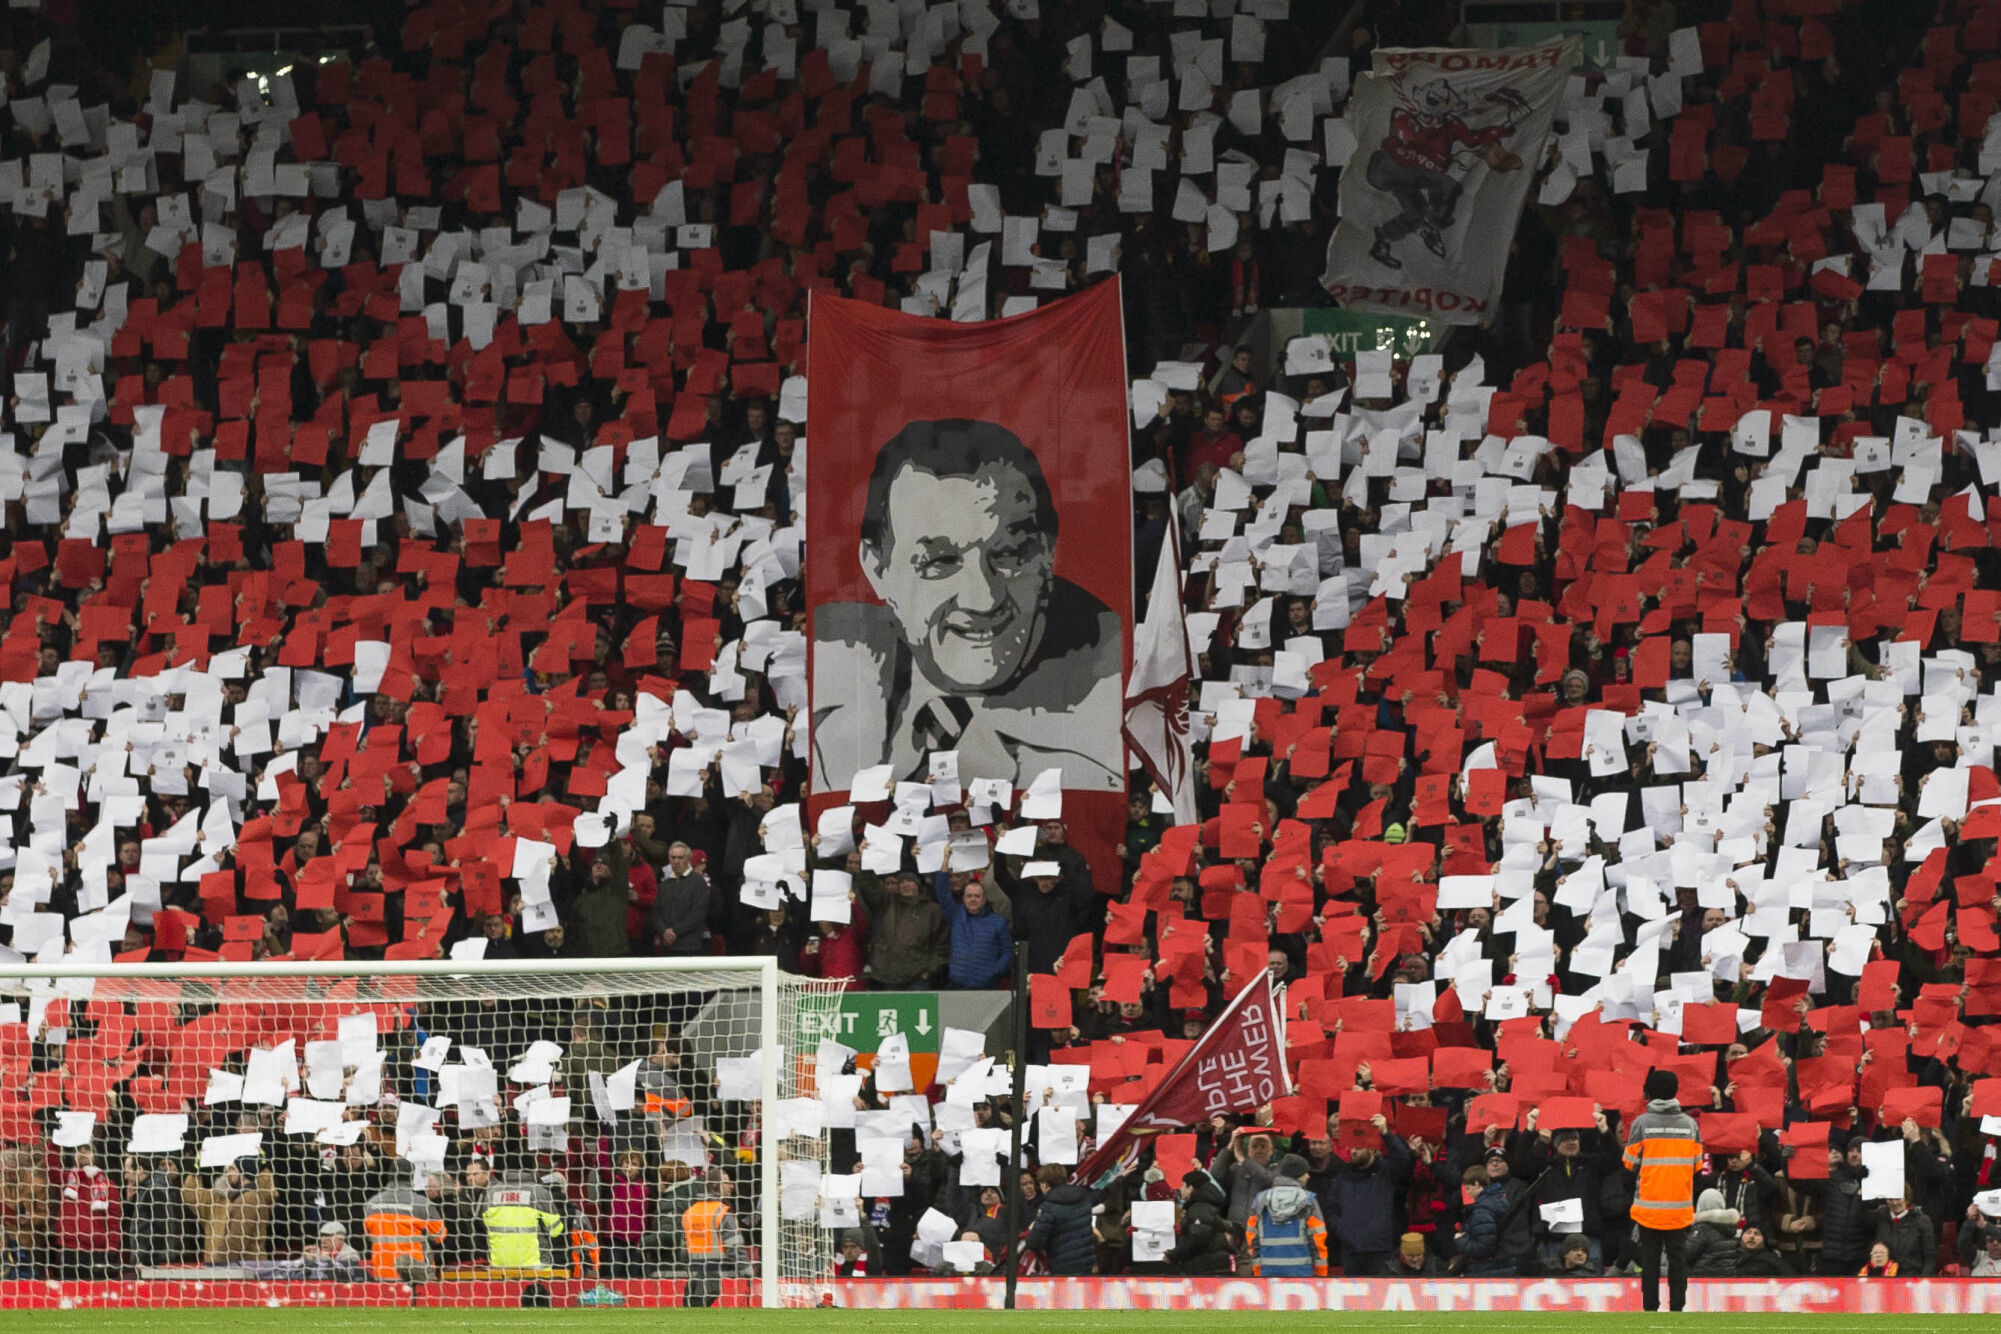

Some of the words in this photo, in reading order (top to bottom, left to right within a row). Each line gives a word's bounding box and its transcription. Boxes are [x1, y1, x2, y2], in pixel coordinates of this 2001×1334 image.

[1309, 332, 1363, 353] XIT
[801, 1012, 859, 1034] EXIT
[500, 1191, 520, 1203] FIRE
